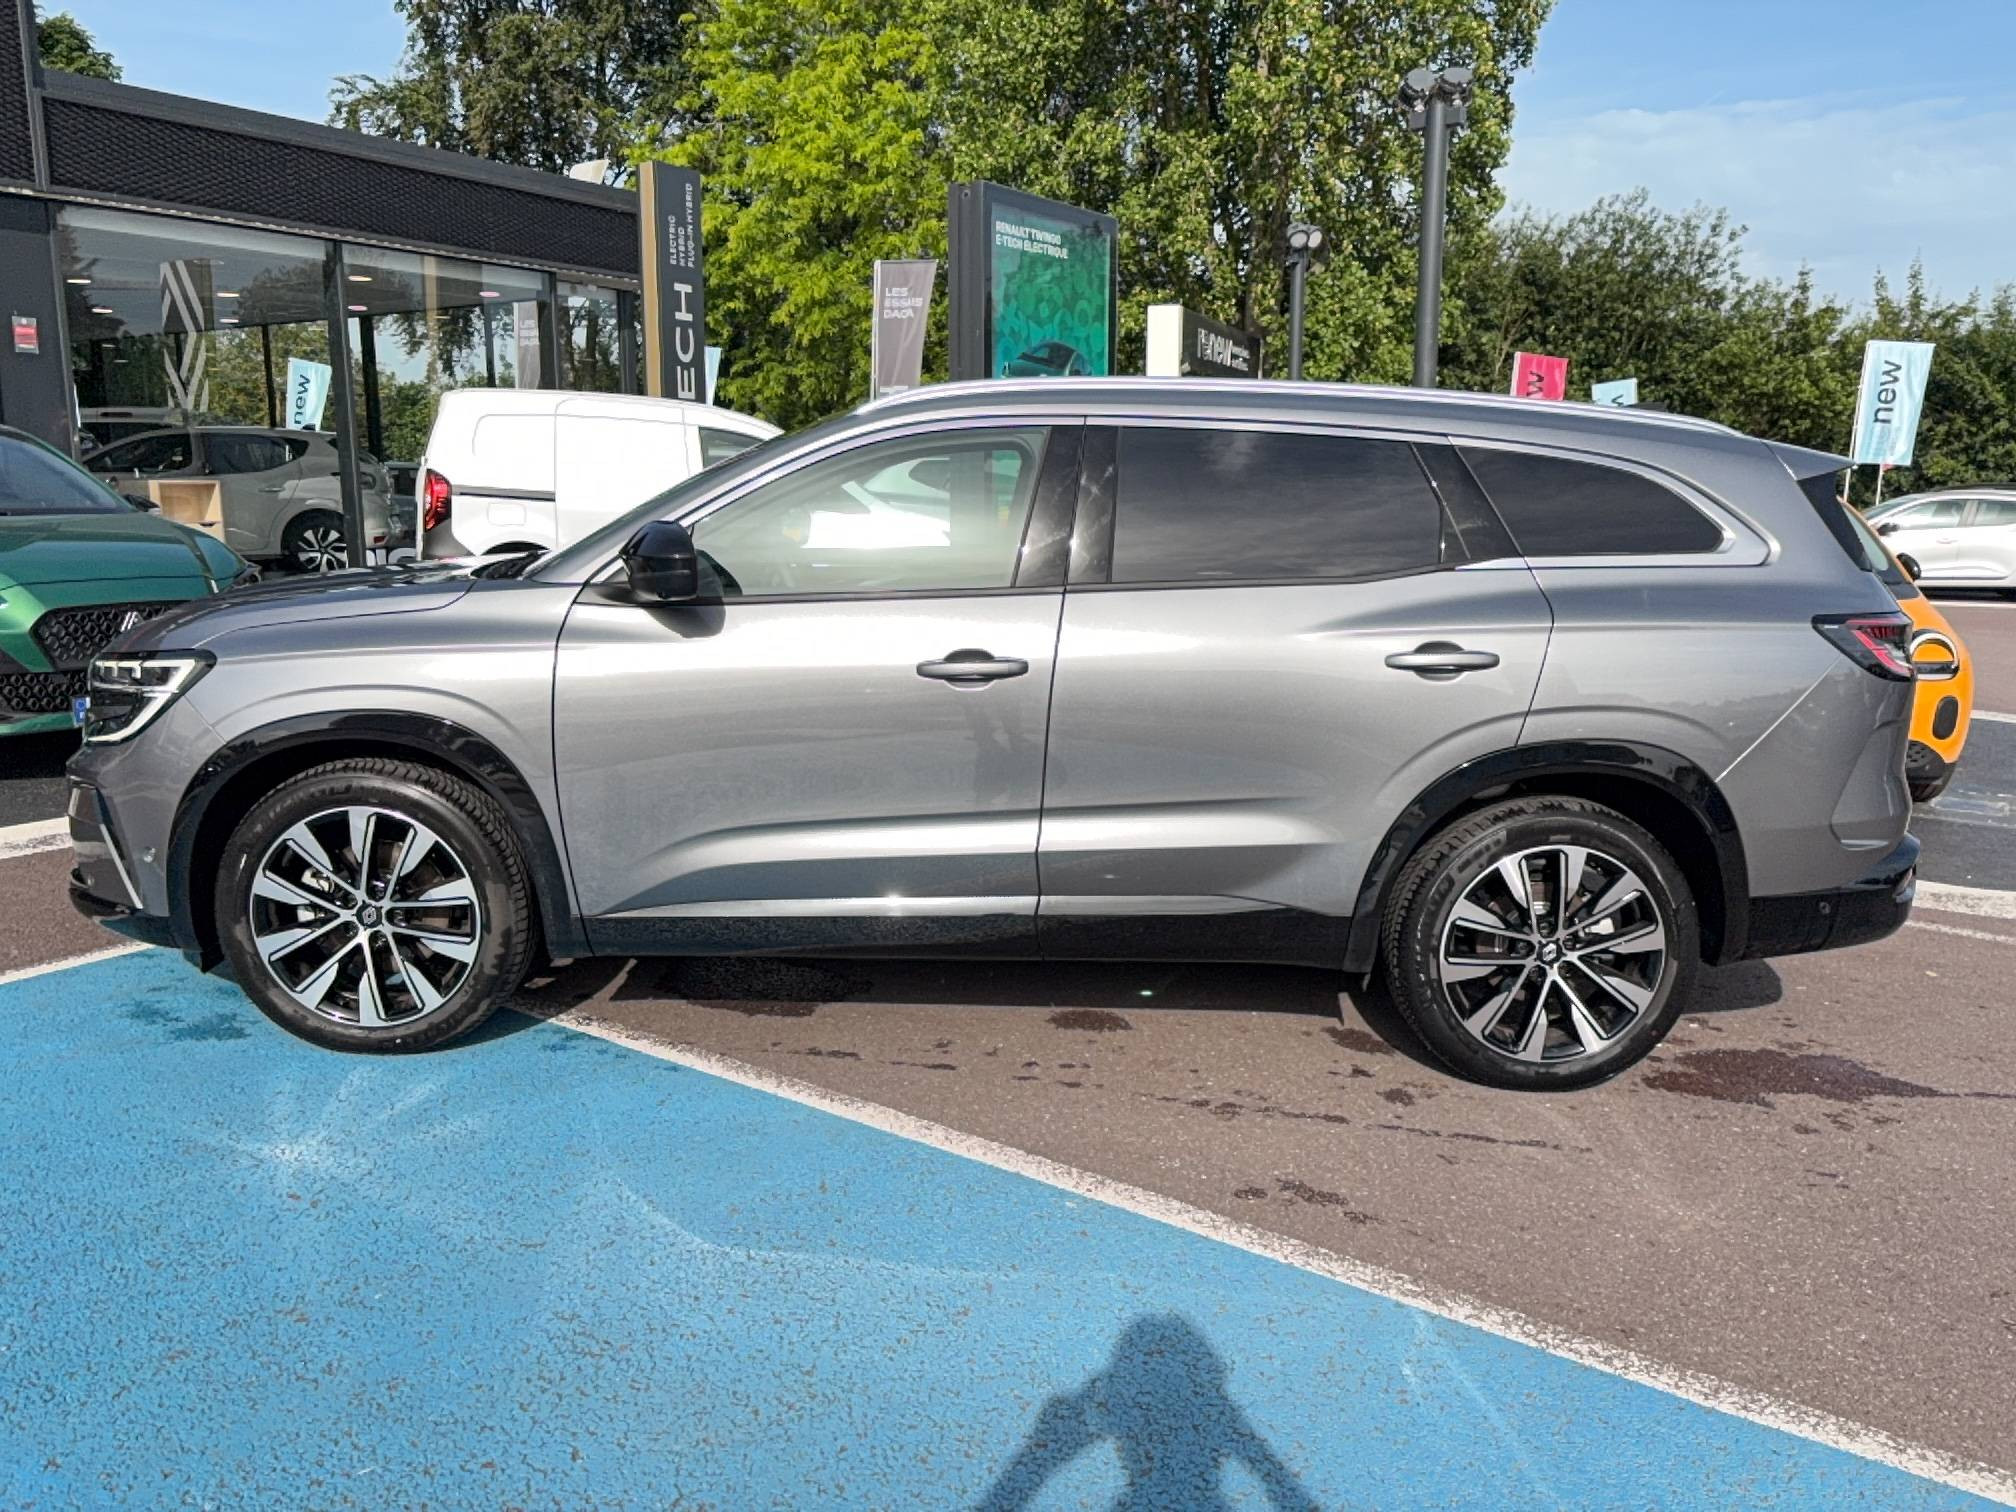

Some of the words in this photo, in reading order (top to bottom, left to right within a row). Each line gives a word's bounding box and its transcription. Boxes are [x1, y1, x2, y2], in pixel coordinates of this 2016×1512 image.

[685, 183, 693, 222] HYBRID
[668, 214, 677, 265] ELECTRIC
[678, 226, 686, 267] HYBRID
[687, 225, 695, 268] PLUG-IN
[294, 374, 311, 425] new
[1873, 360, 1902, 424] new
